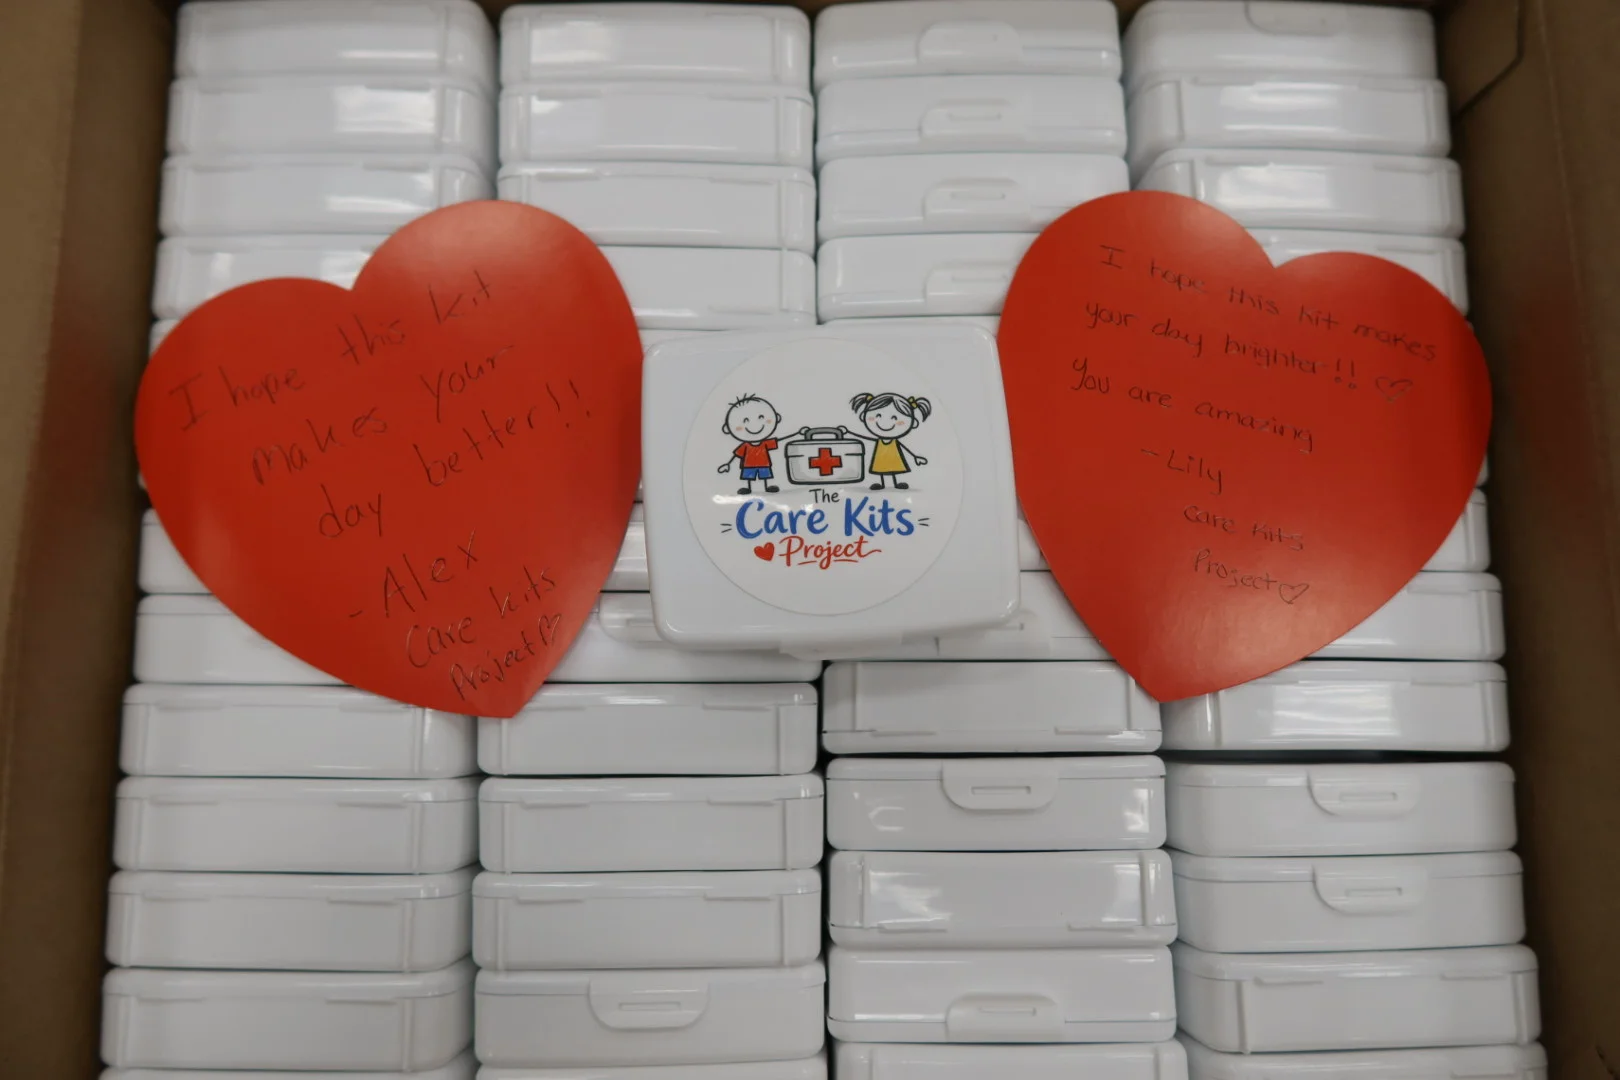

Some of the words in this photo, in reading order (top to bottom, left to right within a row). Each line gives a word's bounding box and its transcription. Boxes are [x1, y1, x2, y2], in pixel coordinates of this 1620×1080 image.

[1086, 302, 1138, 329] your
[1151, 318, 1203, 358] day
[1100, 244, 1124, 269] I
[1150, 259, 1205, 291] hope
[1228, 286, 1279, 315] this
[1353, 322, 1437, 361] makes
[169, 374, 209, 431] I
[219, 366, 306, 407] hope
[337, 314, 406, 365] this
[251, 407, 387, 485] makes
[1128, 383, 1172, 408] are
[1195, 401, 1313, 453] amazing
[319, 484, 382, 538] day
[412, 379, 592, 486] better!!
[736, 498, 829, 539] Care
[844, 496, 915, 537] Kits
[809, 488, 840, 504] The
[383, 528, 478, 618] Alex
[778, 535, 882, 570] Project
[1194, 548, 1277, 590] Project
